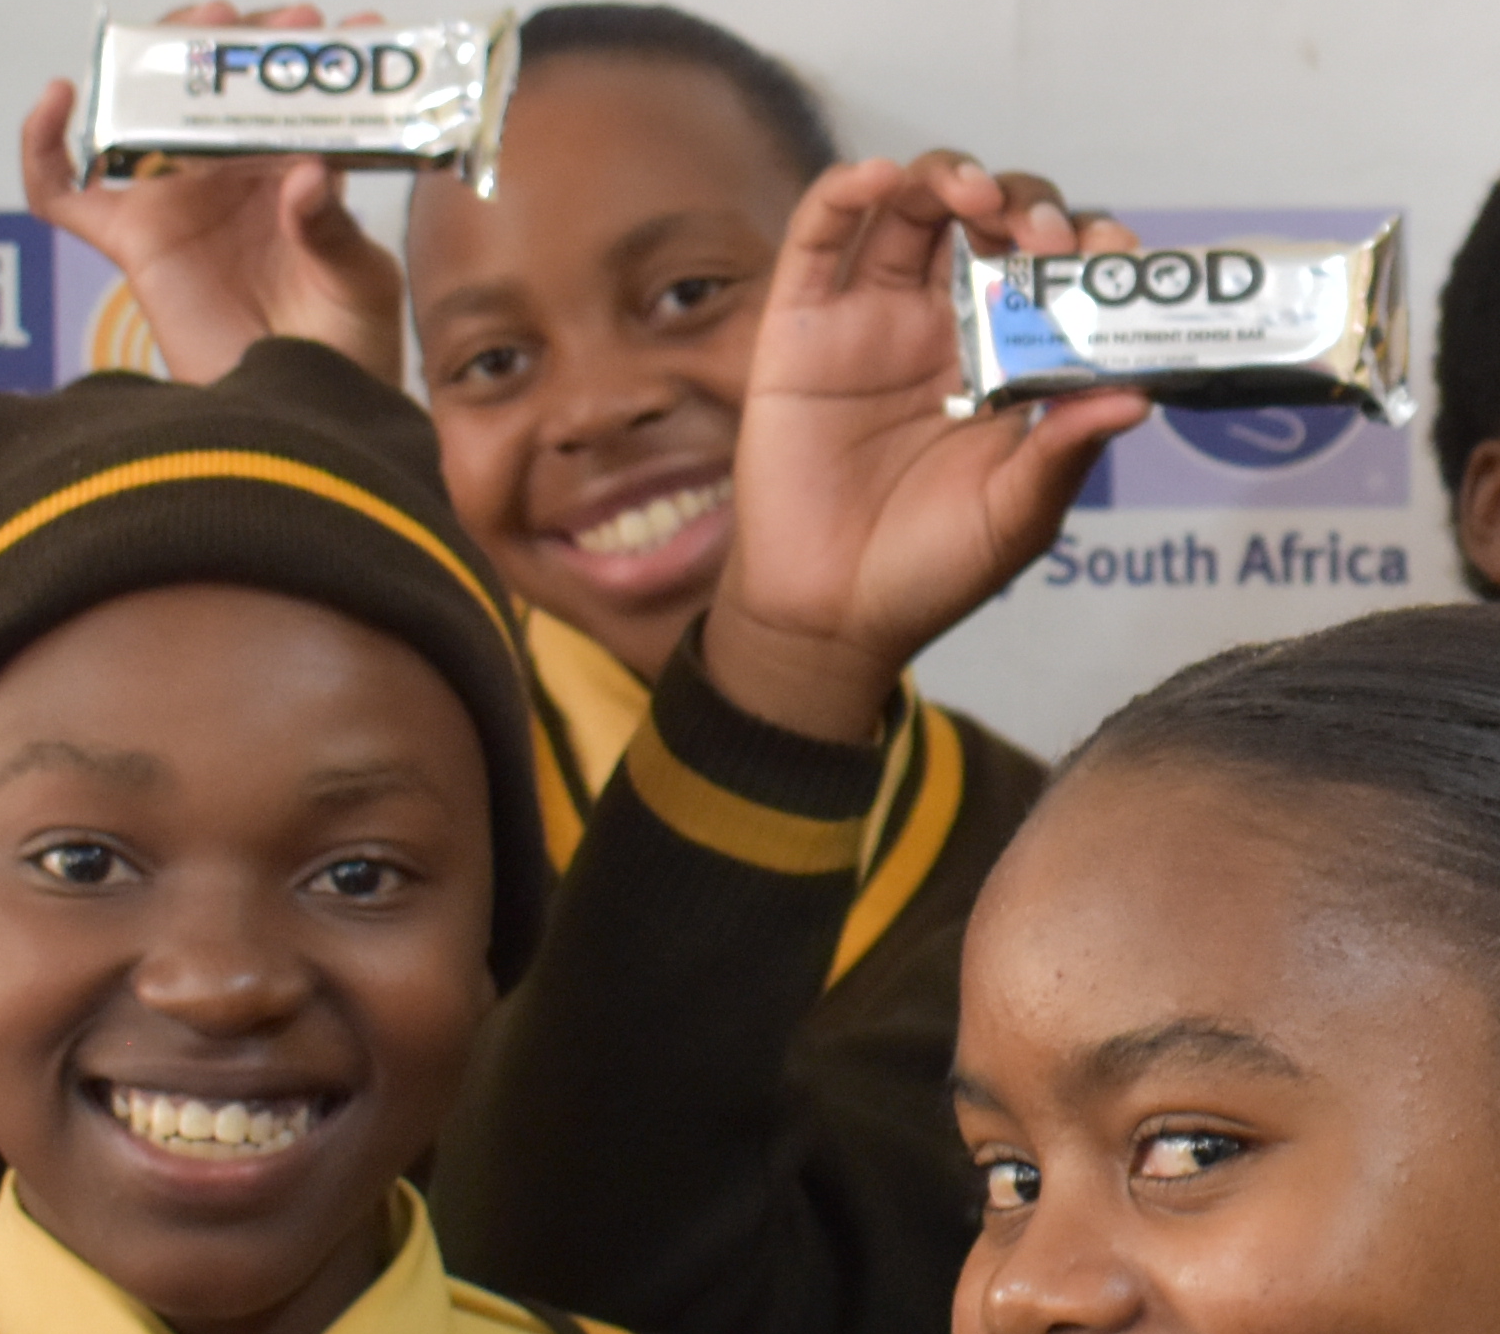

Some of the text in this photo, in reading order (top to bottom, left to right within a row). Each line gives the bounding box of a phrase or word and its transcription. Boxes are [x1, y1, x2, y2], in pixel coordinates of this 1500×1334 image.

[214, 41, 424, 95] FOOD
[1032, 250, 1265, 309] FOOD
[1046, 531, 1408, 589] South Africa
